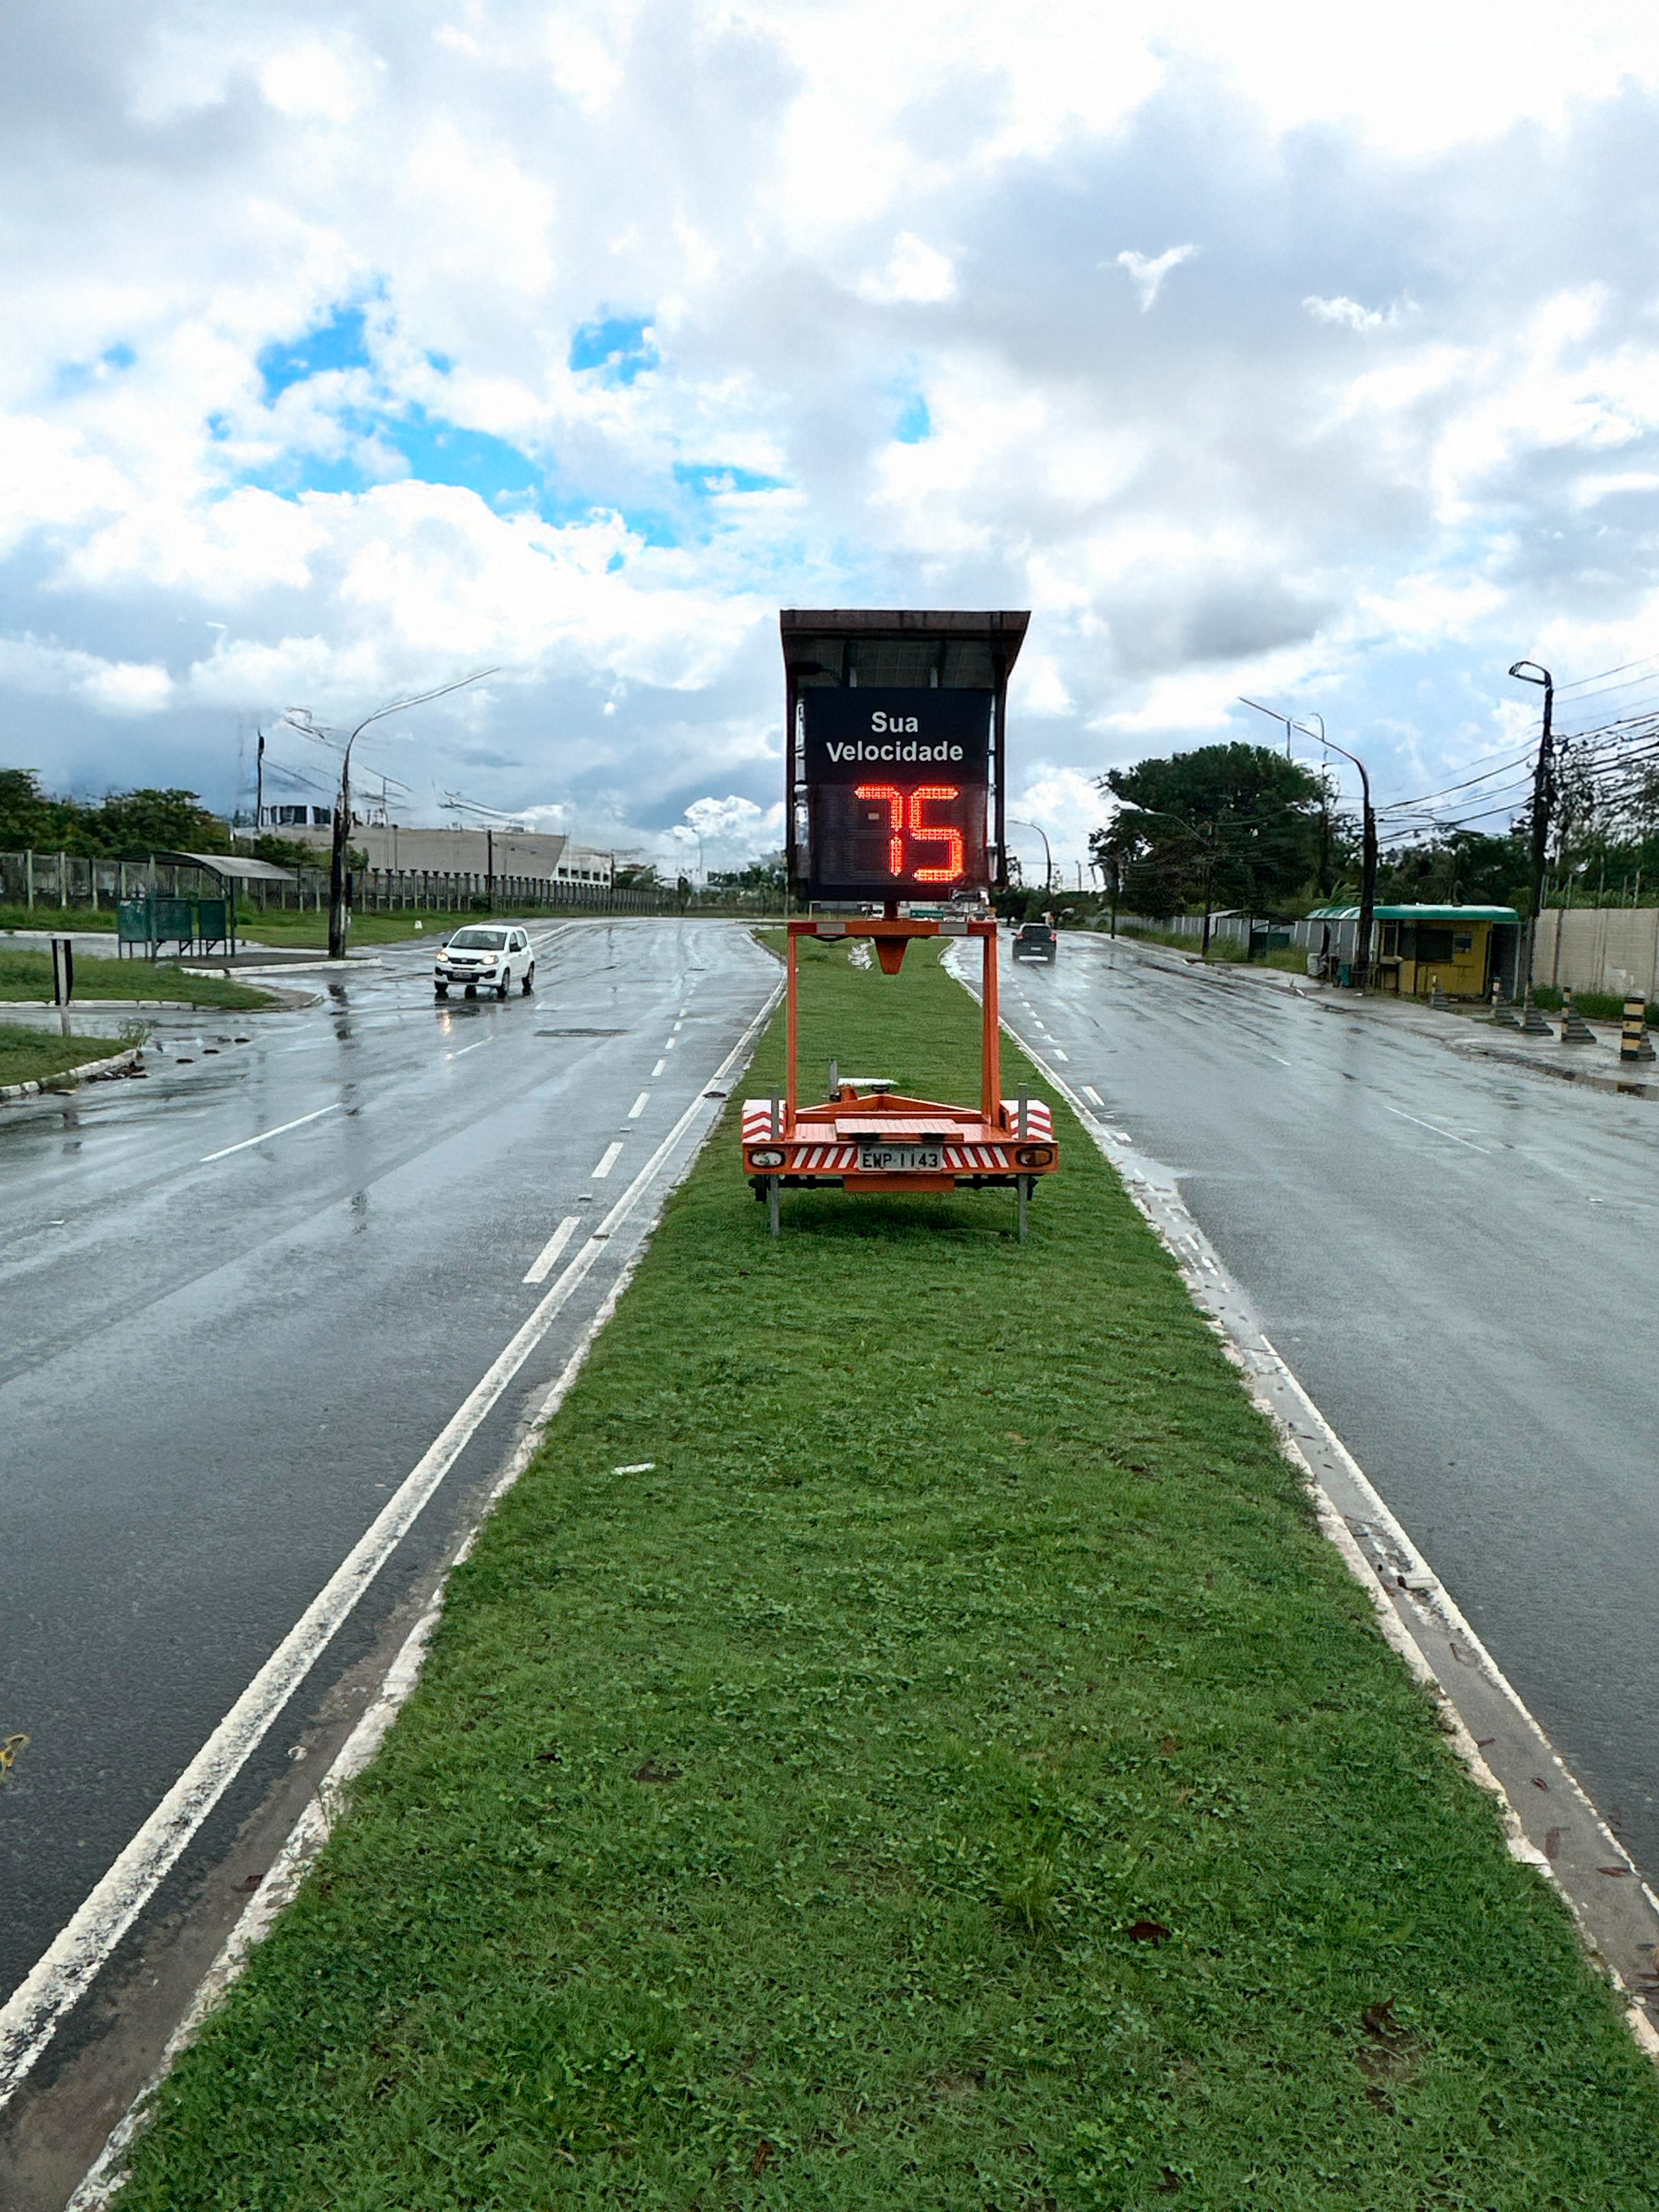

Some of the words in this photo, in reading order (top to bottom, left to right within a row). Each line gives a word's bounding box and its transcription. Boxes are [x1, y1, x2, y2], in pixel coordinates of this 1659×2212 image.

[871, 712, 918, 733] Sua
[826, 741, 963, 762] Velocidade
[854, 785, 963, 882] 75
